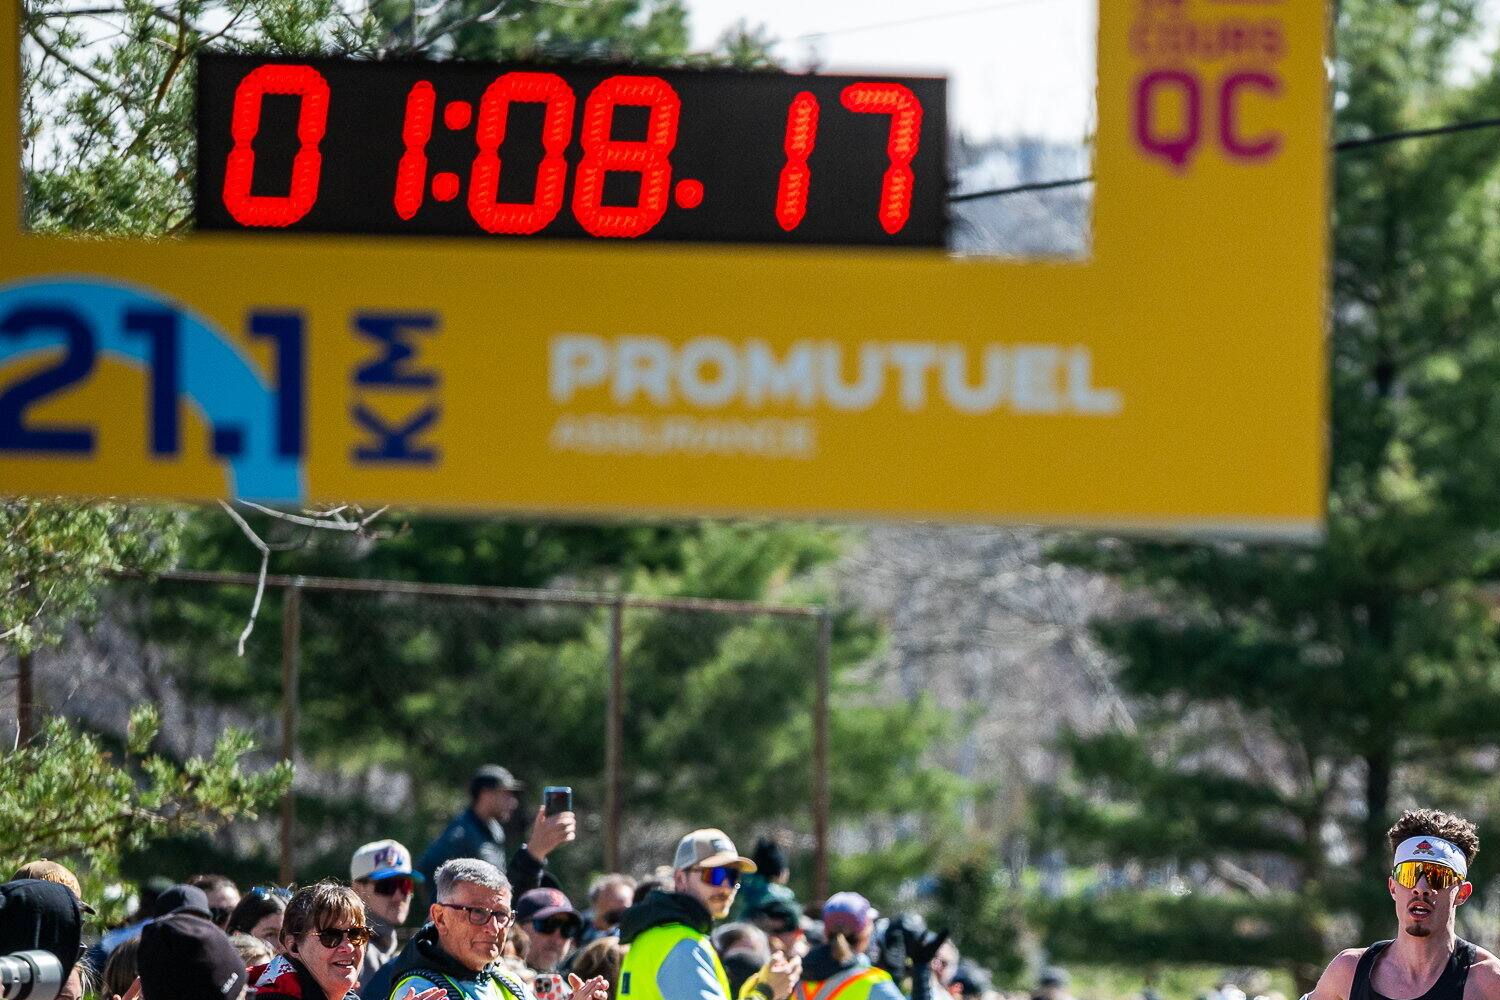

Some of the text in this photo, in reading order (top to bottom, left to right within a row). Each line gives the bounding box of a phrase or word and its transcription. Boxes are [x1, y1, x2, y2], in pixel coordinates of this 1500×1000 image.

[1130, 68, 1284, 176] QC
[0, 304, 442, 467] 21.1 KM
[549, 335, 1122, 415] PROMUTUEL
